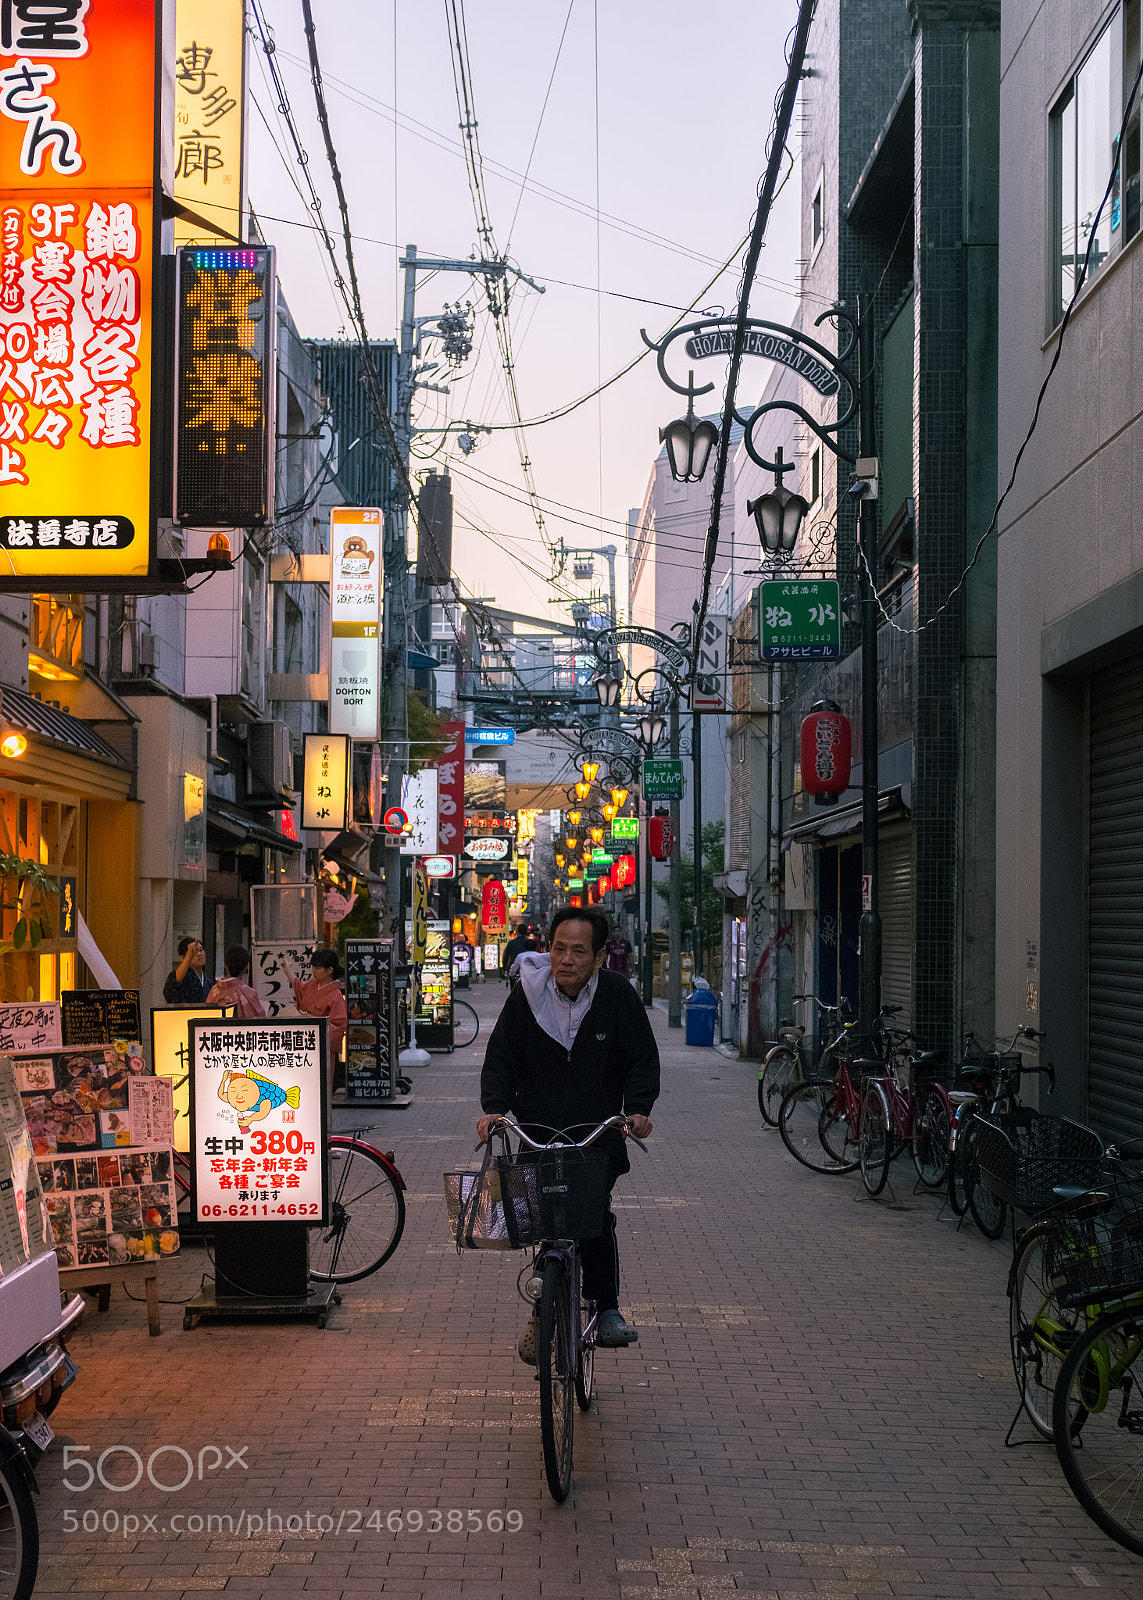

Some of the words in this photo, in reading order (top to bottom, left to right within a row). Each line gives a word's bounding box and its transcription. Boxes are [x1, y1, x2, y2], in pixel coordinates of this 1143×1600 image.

[84, 202, 137, 445] 鍋物各種
[363, 512, 378, 522] 2F
[7, 520, 118, 547] 法善寺店
[363, 627, 377, 636] 1F
[770, 646, 832, 657] アサヒビール
[645, 772, 681, 784] まんてんや
[471, 839, 505, 852] お好み焼
[488, 886, 500, 925] お好み焼
[348, 945, 357, 953] ALL
[199, 1030, 316, 1053] 大阪中央卸売市場直送
[377, 1013, 390, 1078] JACKAL
[203, 1052, 313, 1069] さかな屋さんの居酒屋さん
[204, 1136, 244, 1155] 生中
[210, 1157, 308, 1173] 忘年会・新年会
[218, 1174, 249, 1189] 各種
[255, 1173, 300, 1189] ご宴会
[238, 1190, 281, 1201] 承ります
[201, 1203, 319, 1217] 06-6211-4652
